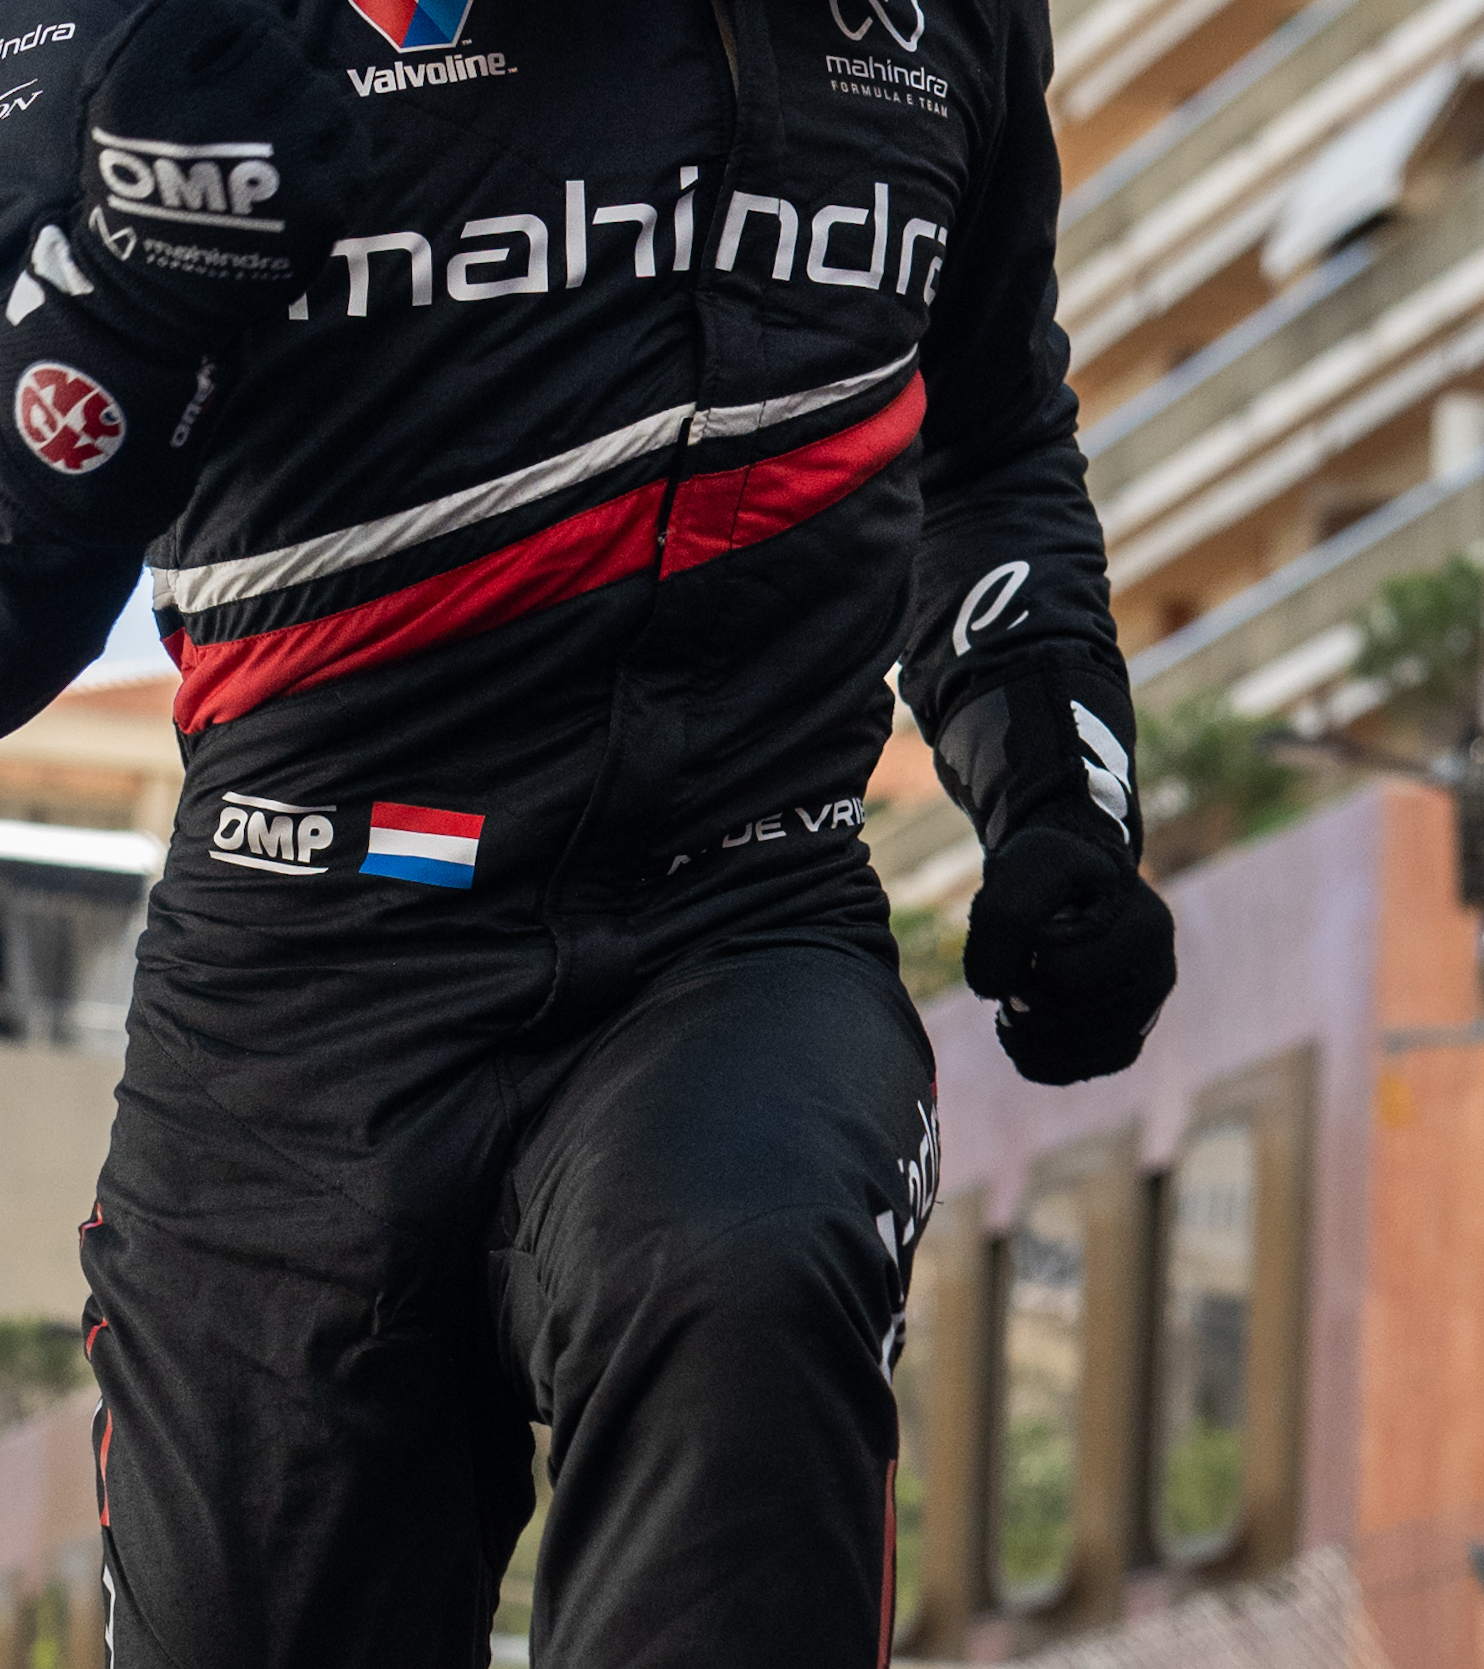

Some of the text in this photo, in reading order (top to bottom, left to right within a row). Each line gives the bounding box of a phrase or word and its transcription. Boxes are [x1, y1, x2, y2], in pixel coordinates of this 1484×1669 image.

[347, 50, 500, 98] Valvoline
[826, 55, 949, 98] mahindra
[830, 80, 949, 119] FORMULA E TEAM
[98, 148, 281, 215] OMP
[213, 807, 335, 863] OMP
